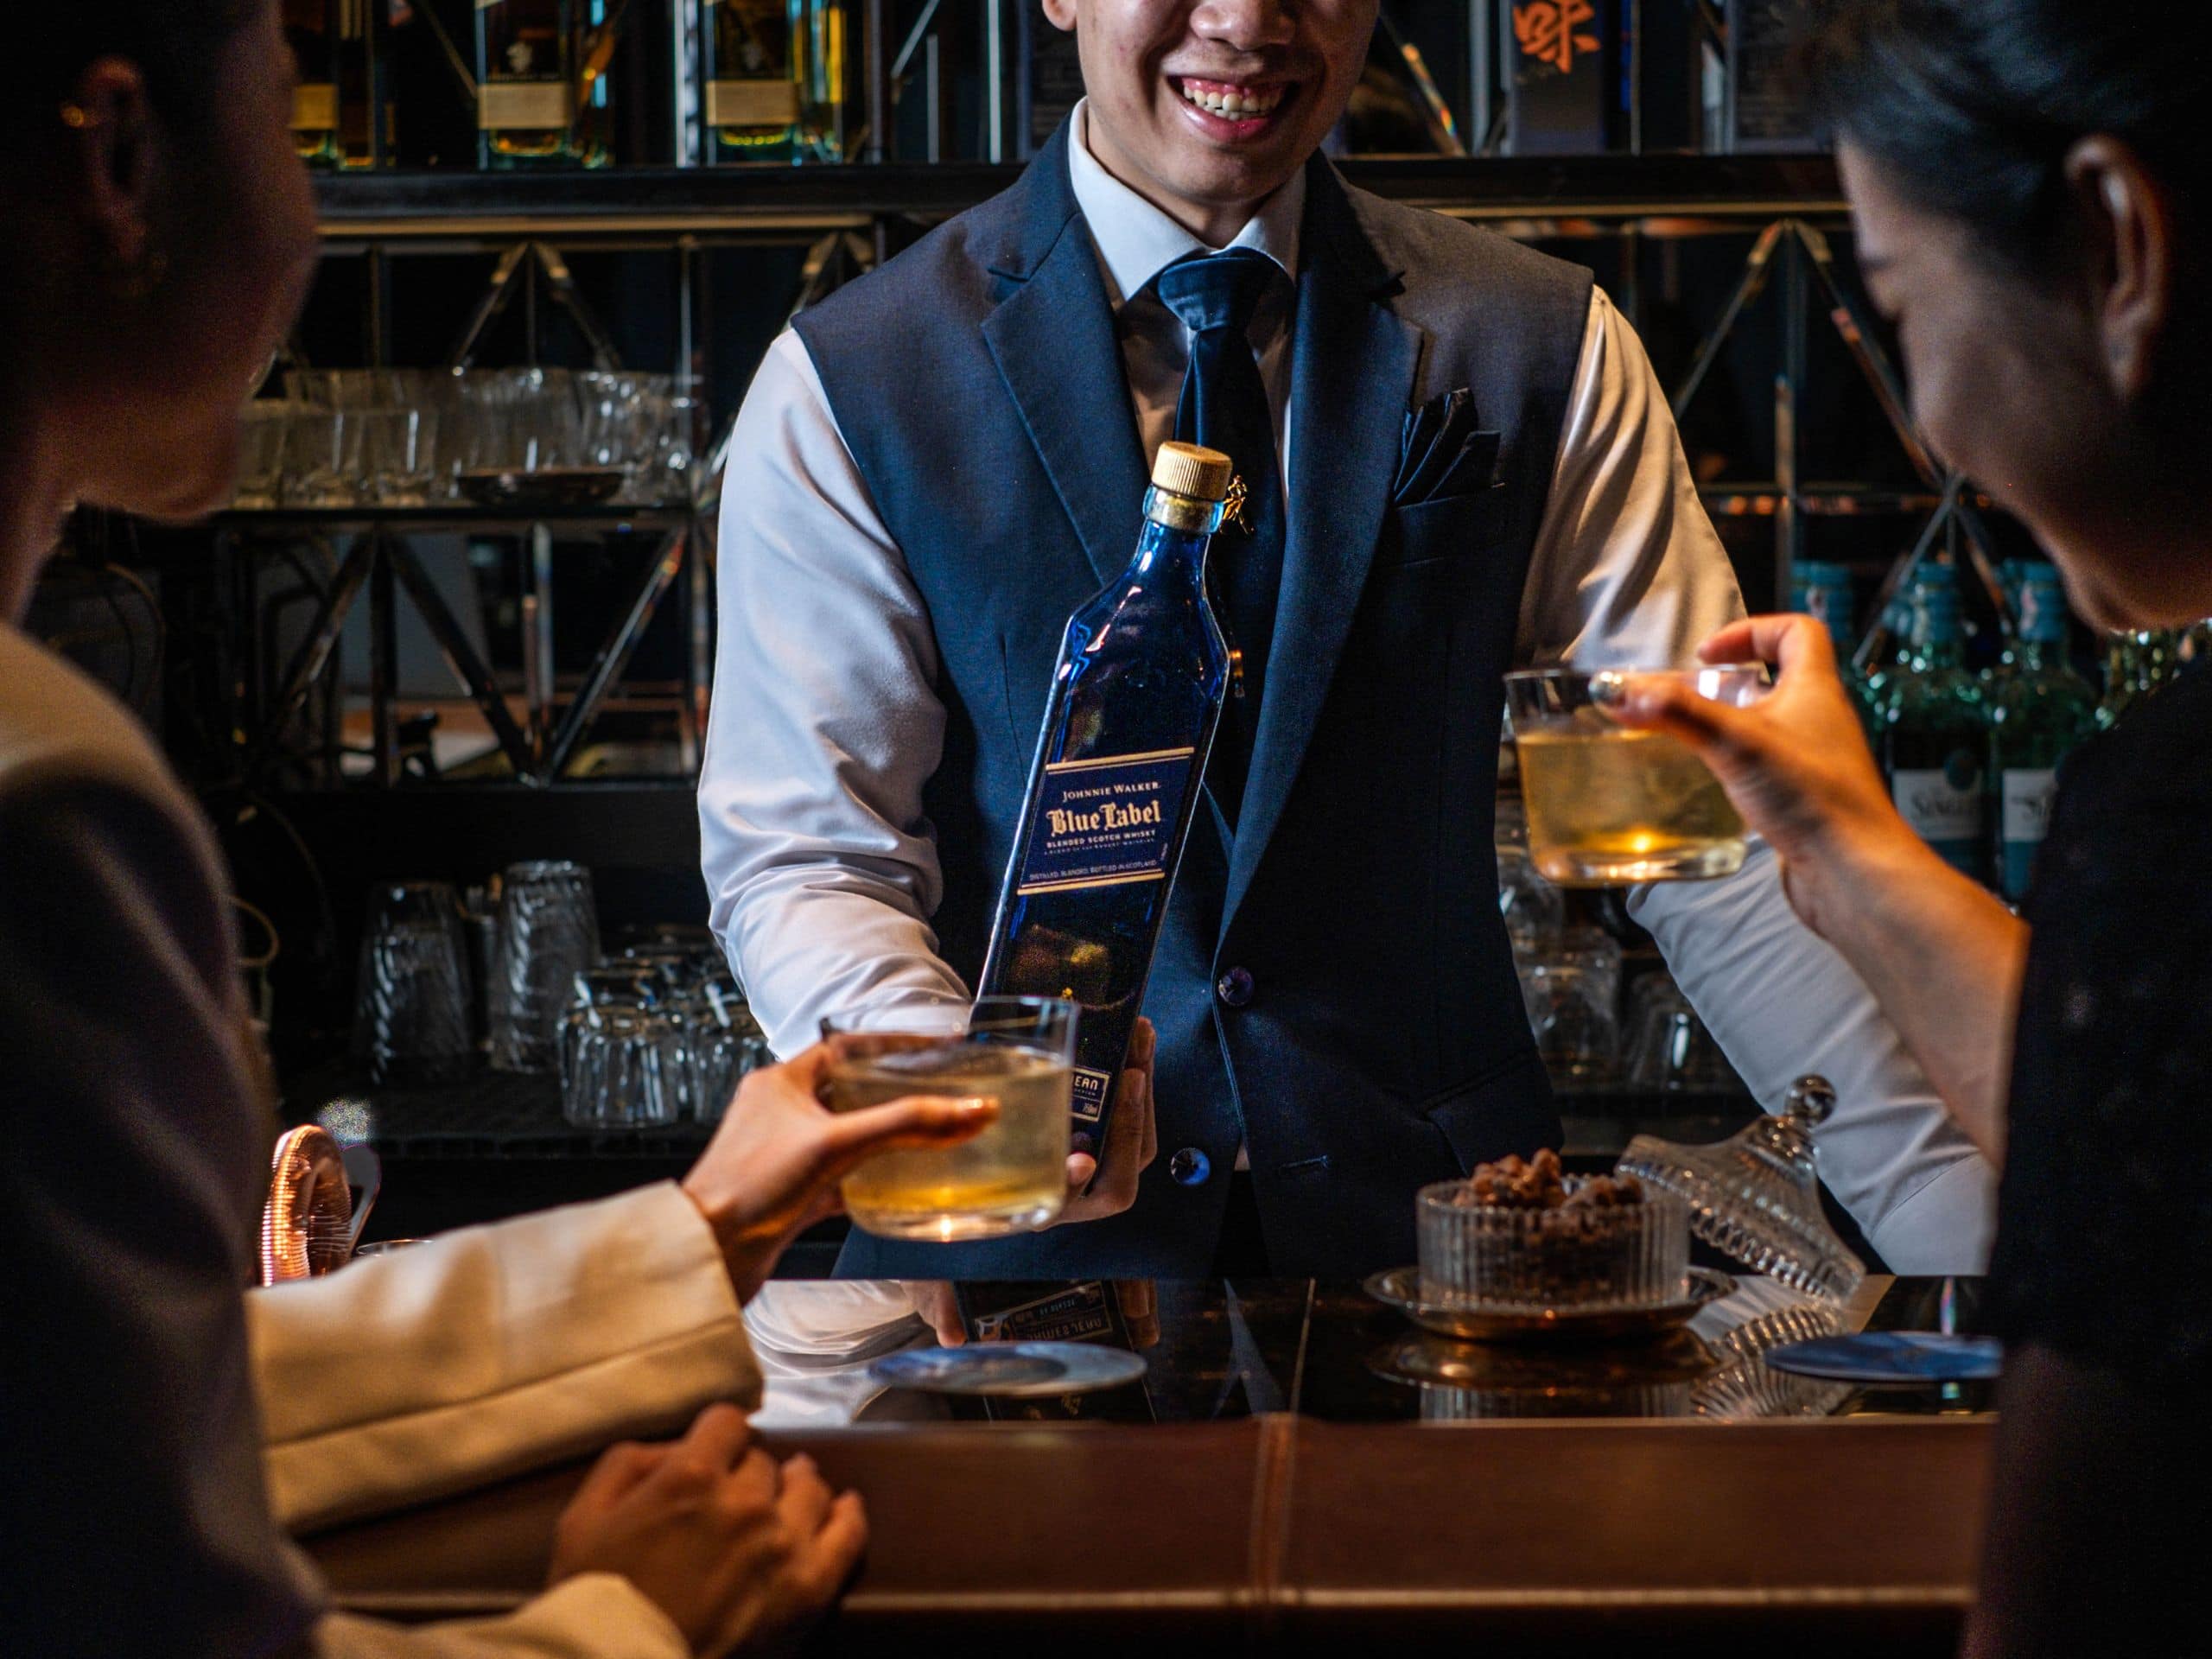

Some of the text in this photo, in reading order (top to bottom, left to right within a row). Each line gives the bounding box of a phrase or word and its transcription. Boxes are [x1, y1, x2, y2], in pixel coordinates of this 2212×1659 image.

[1063, 782, 1160, 803] JOHNNIE WALKER
[1046, 799, 1162, 837] Blue Label
[1046, 837, 1085, 849] BLENDED
[1088, 833, 1121, 843] SCOTCH
[1122, 830, 1156, 840] WHISKY
[1071, 1075, 1098, 1090] EAN
